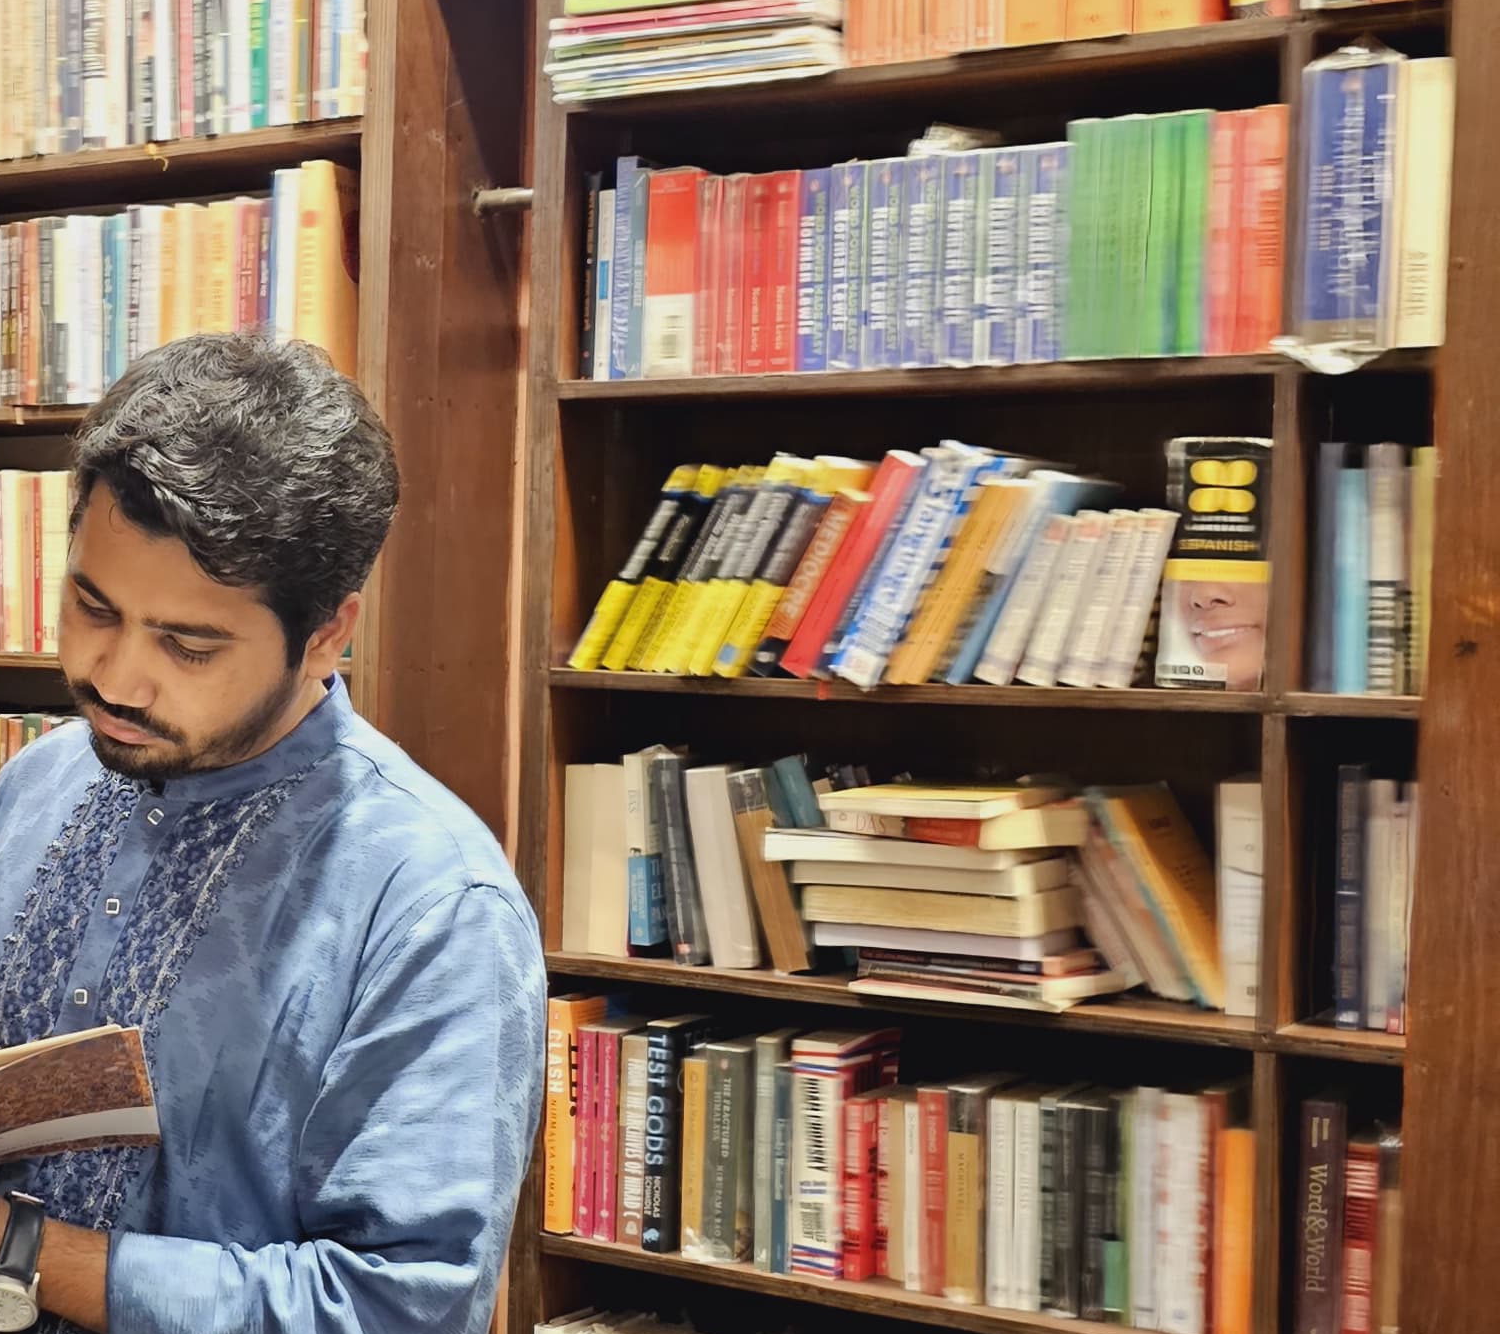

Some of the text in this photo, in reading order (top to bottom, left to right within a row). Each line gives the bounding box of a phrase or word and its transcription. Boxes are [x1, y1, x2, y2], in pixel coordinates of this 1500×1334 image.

[798, 216, 815, 335] Norman Lewis
[833, 209, 849, 330] Norman Lewis
[871, 207, 888, 330] Norman Lewis
[780, 510, 851, 620] MEDIOCRE
[547, 1029, 564, 1094] CLASH
[645, 1035, 667, 1165] TEST GODS
[625, 1162, 641, 1175] OF
[721, 1099, 731, 1158] FRACTURED
[624, 1177, 640, 1209] NIRAD
